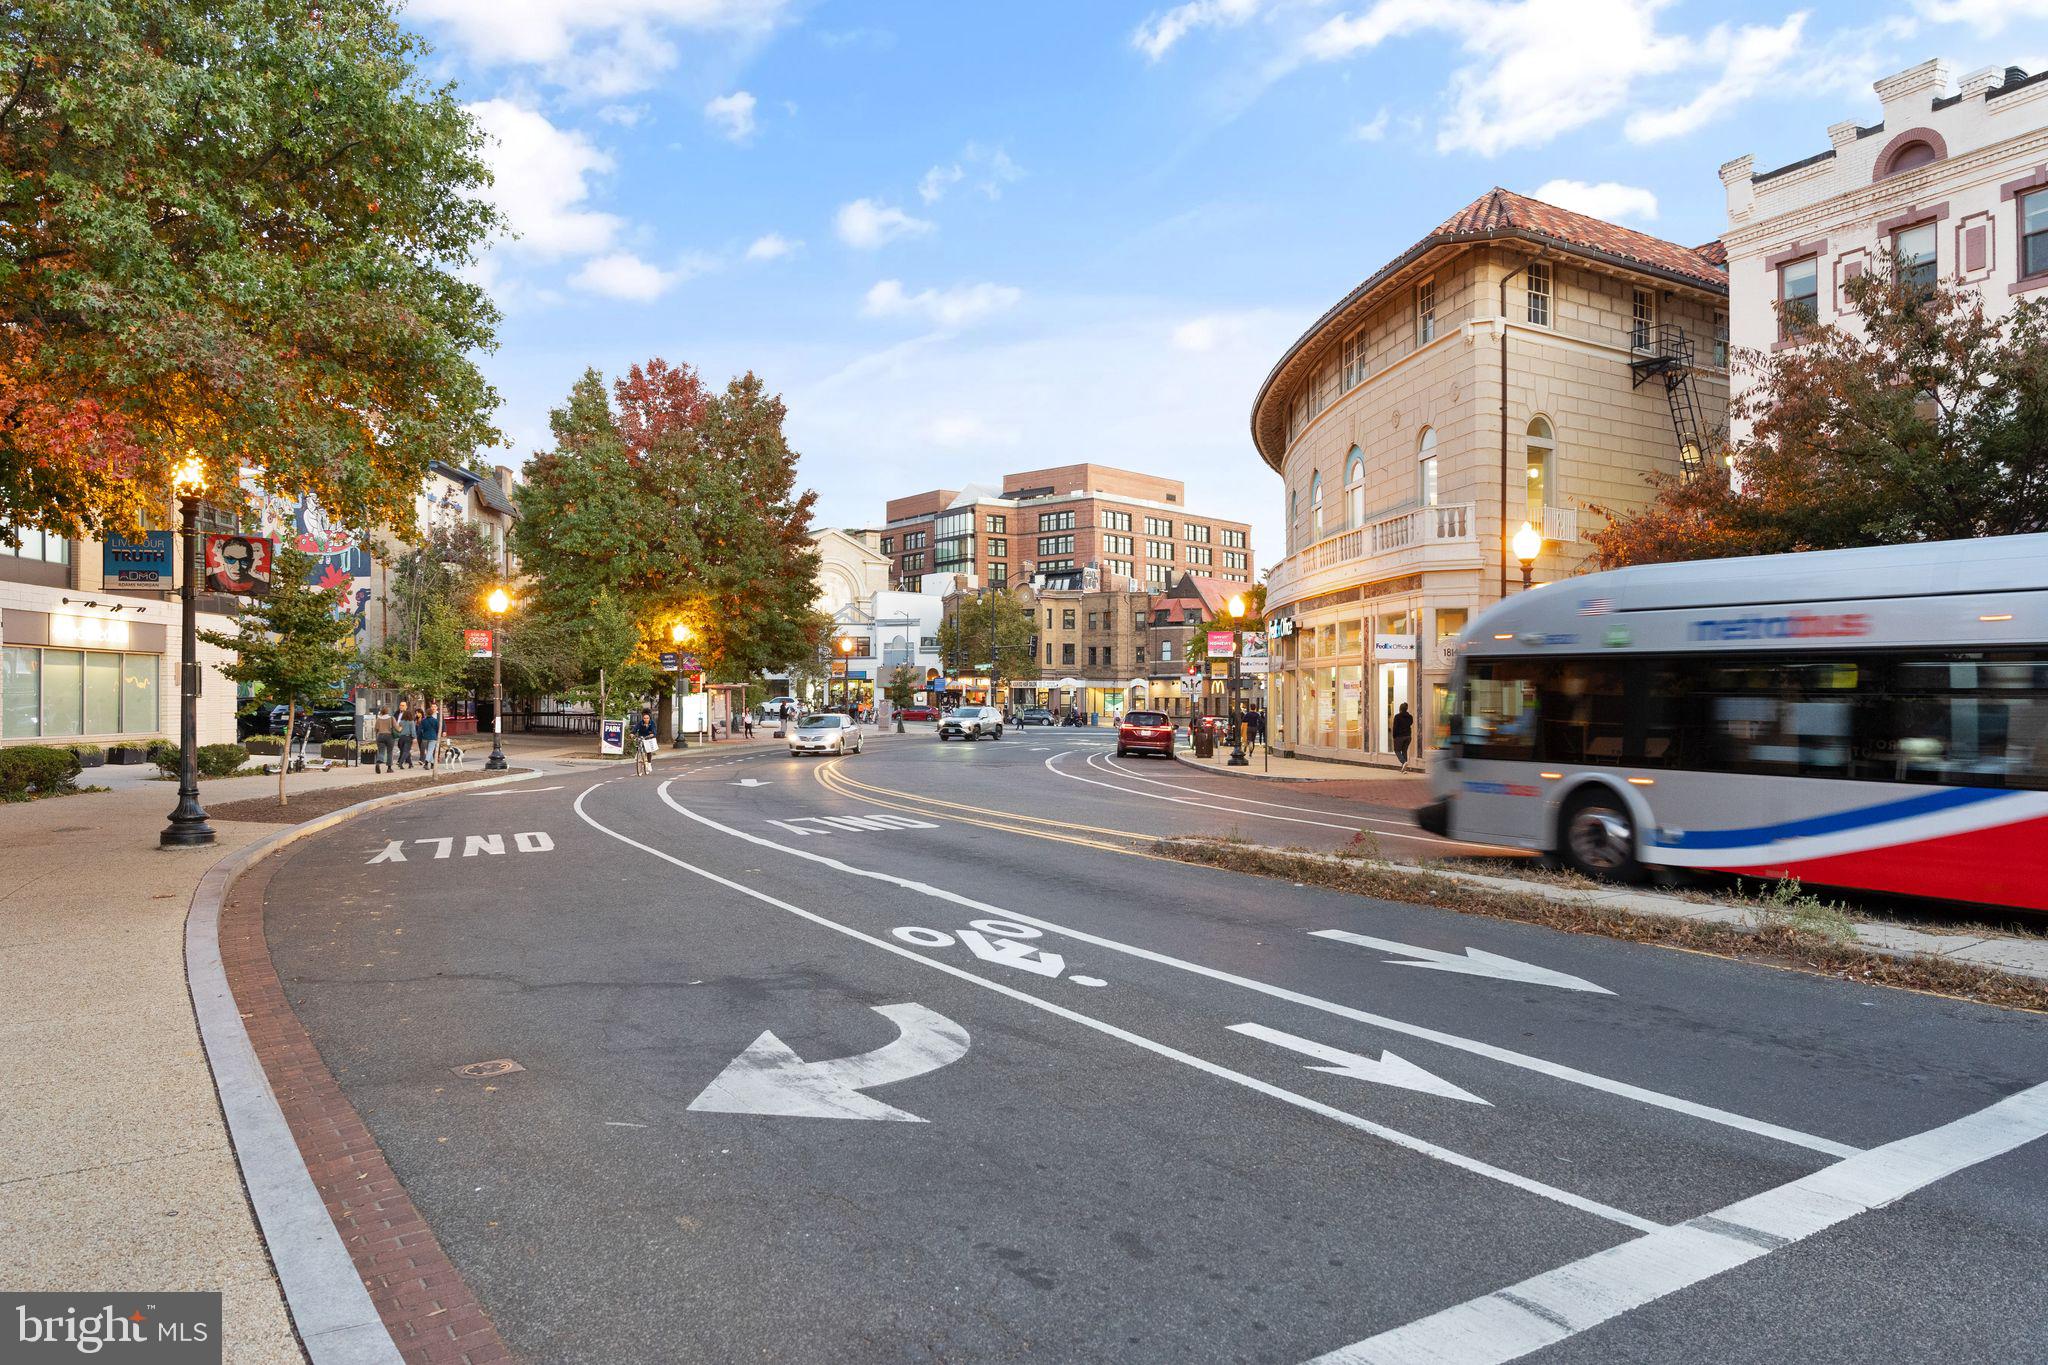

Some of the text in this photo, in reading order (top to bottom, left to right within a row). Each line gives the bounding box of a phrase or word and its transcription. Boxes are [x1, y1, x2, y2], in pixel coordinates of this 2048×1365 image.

[138, 540, 165, 548] OUR
[111, 549, 165, 562] TRUTH
[119, 571, 158, 581] ADMO
[1269, 617, 1293, 640] FedEx Office
[1376, 642, 1393, 650] FedEx
[764, 814, 940, 836] ONLY
[364, 832, 555, 864] ONLY
